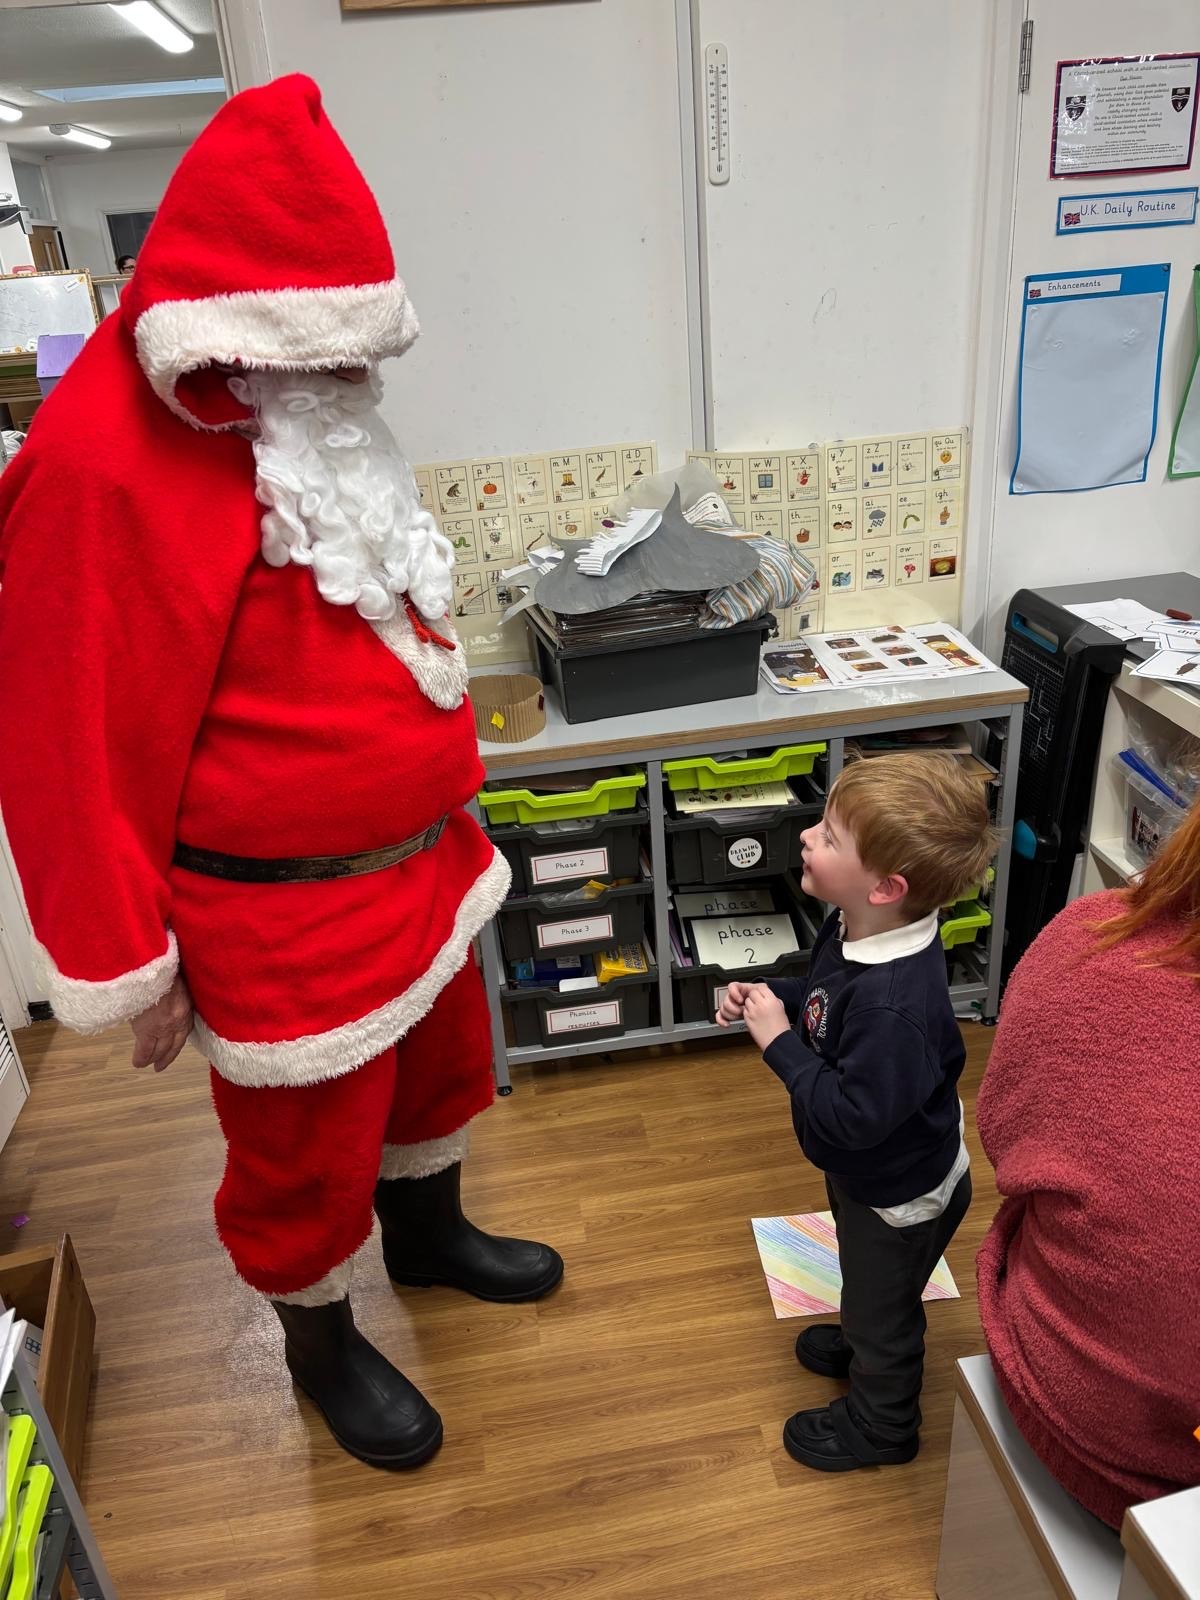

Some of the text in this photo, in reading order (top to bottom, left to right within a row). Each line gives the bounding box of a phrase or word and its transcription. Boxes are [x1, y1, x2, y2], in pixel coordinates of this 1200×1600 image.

[1080, 200, 1176, 217] U.K. Daily Routine
[1048, 279, 1101, 291] Enhancements
[597, 454, 604, 462] N
[635, 449, 641, 458] D
[563, 458, 570, 466] M
[726, 461, 732, 469] V
[764, 459, 772, 468] W
[800, 456, 807, 465] X
[935, 490, 948, 500] igh
[602, 506, 608, 515] U
[831, 503, 843, 512] ng
[755, 511, 765, 521] th
[791, 510, 800, 520] th
[730, 843, 759, 856] DRAWING
[736, 851, 756, 862] CLUB
[555, 862, 577, 870] Phase
[704, 897, 760, 916] phase
[718, 924, 774, 945] phase
[744, 947, 758, 964] 2
[569, 1010, 597, 1018] Phonics
